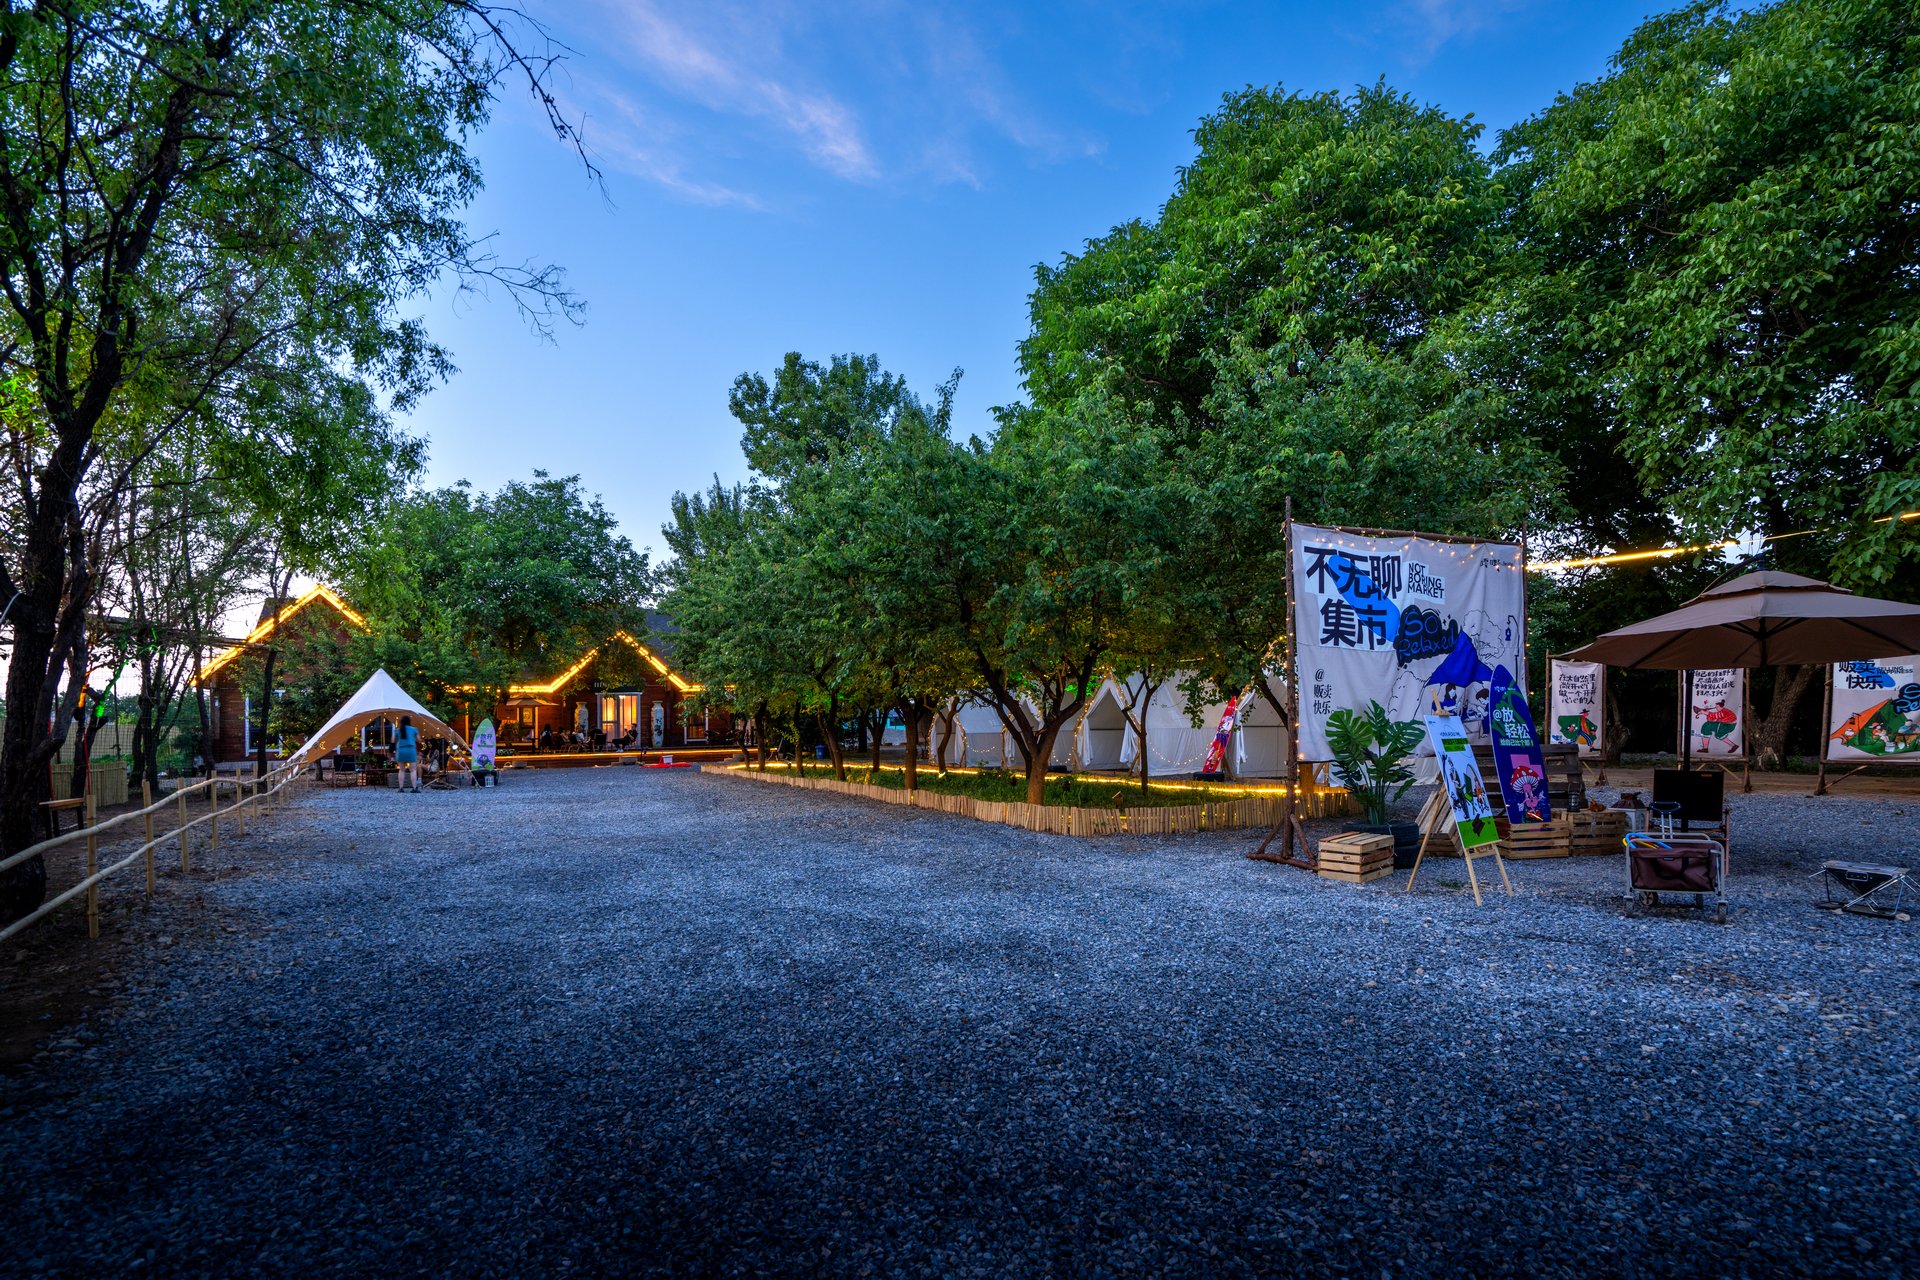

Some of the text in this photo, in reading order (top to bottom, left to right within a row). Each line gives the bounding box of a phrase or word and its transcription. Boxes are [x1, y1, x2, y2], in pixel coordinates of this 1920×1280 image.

[1304, 546, 1402, 600] 不无聊
[1408, 562, 1426, 575] NOT
[1408, 572, 1442, 589] BORING
[1407, 583, 1445, 599] MARKET
[1320, 598, 1388, 650] 集市
[1315, 668, 1325, 682] @
[1838, 660, 1876, 674] 贩卖
[1845, 674, 1884, 690] 快乐
[1313, 684, 1332, 699] 贩卖
[1493, 707, 1515, 722] @放
[1504, 722, 1531, 739] 轻松
